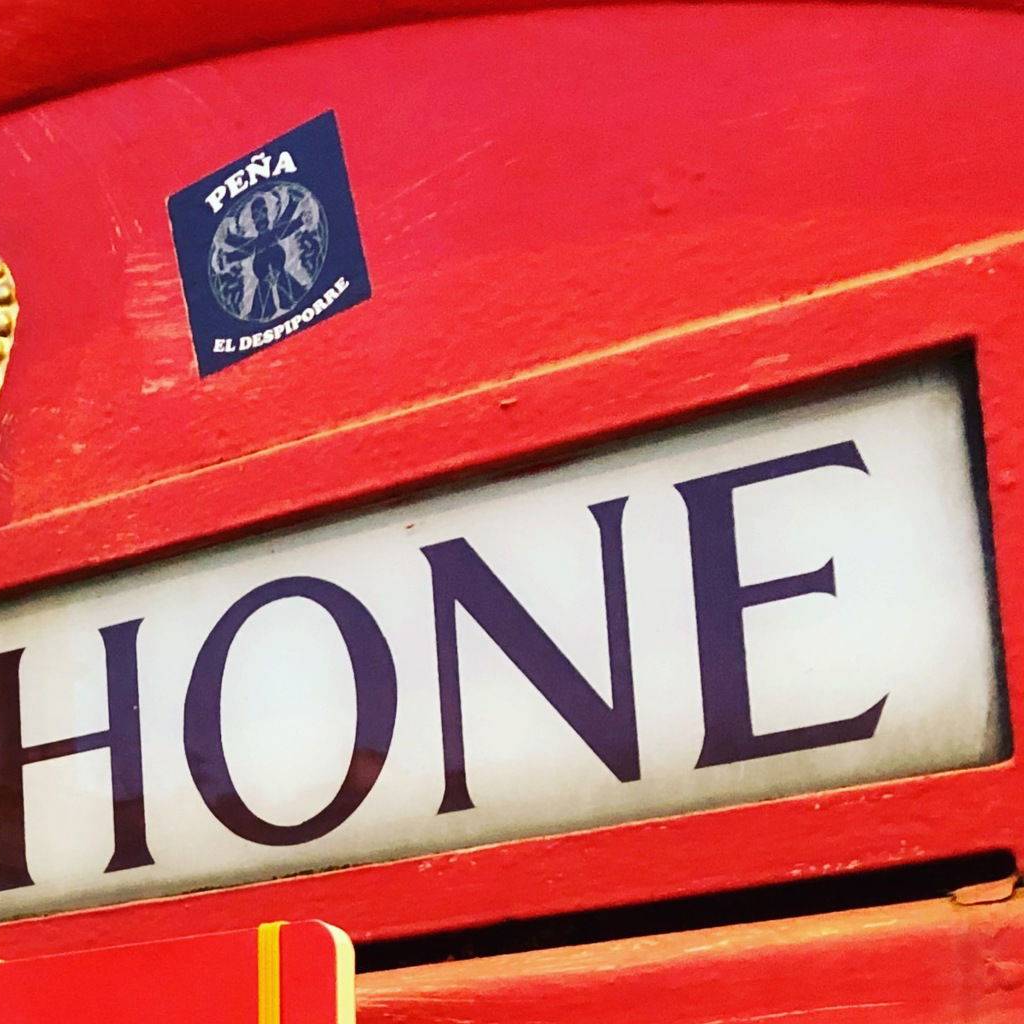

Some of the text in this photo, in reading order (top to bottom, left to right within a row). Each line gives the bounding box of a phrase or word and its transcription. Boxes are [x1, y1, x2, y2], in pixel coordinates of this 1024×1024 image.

[205, 150, 297, 214] PEÑA
[212, 276, 350, 353] EL DESPIPORRE
